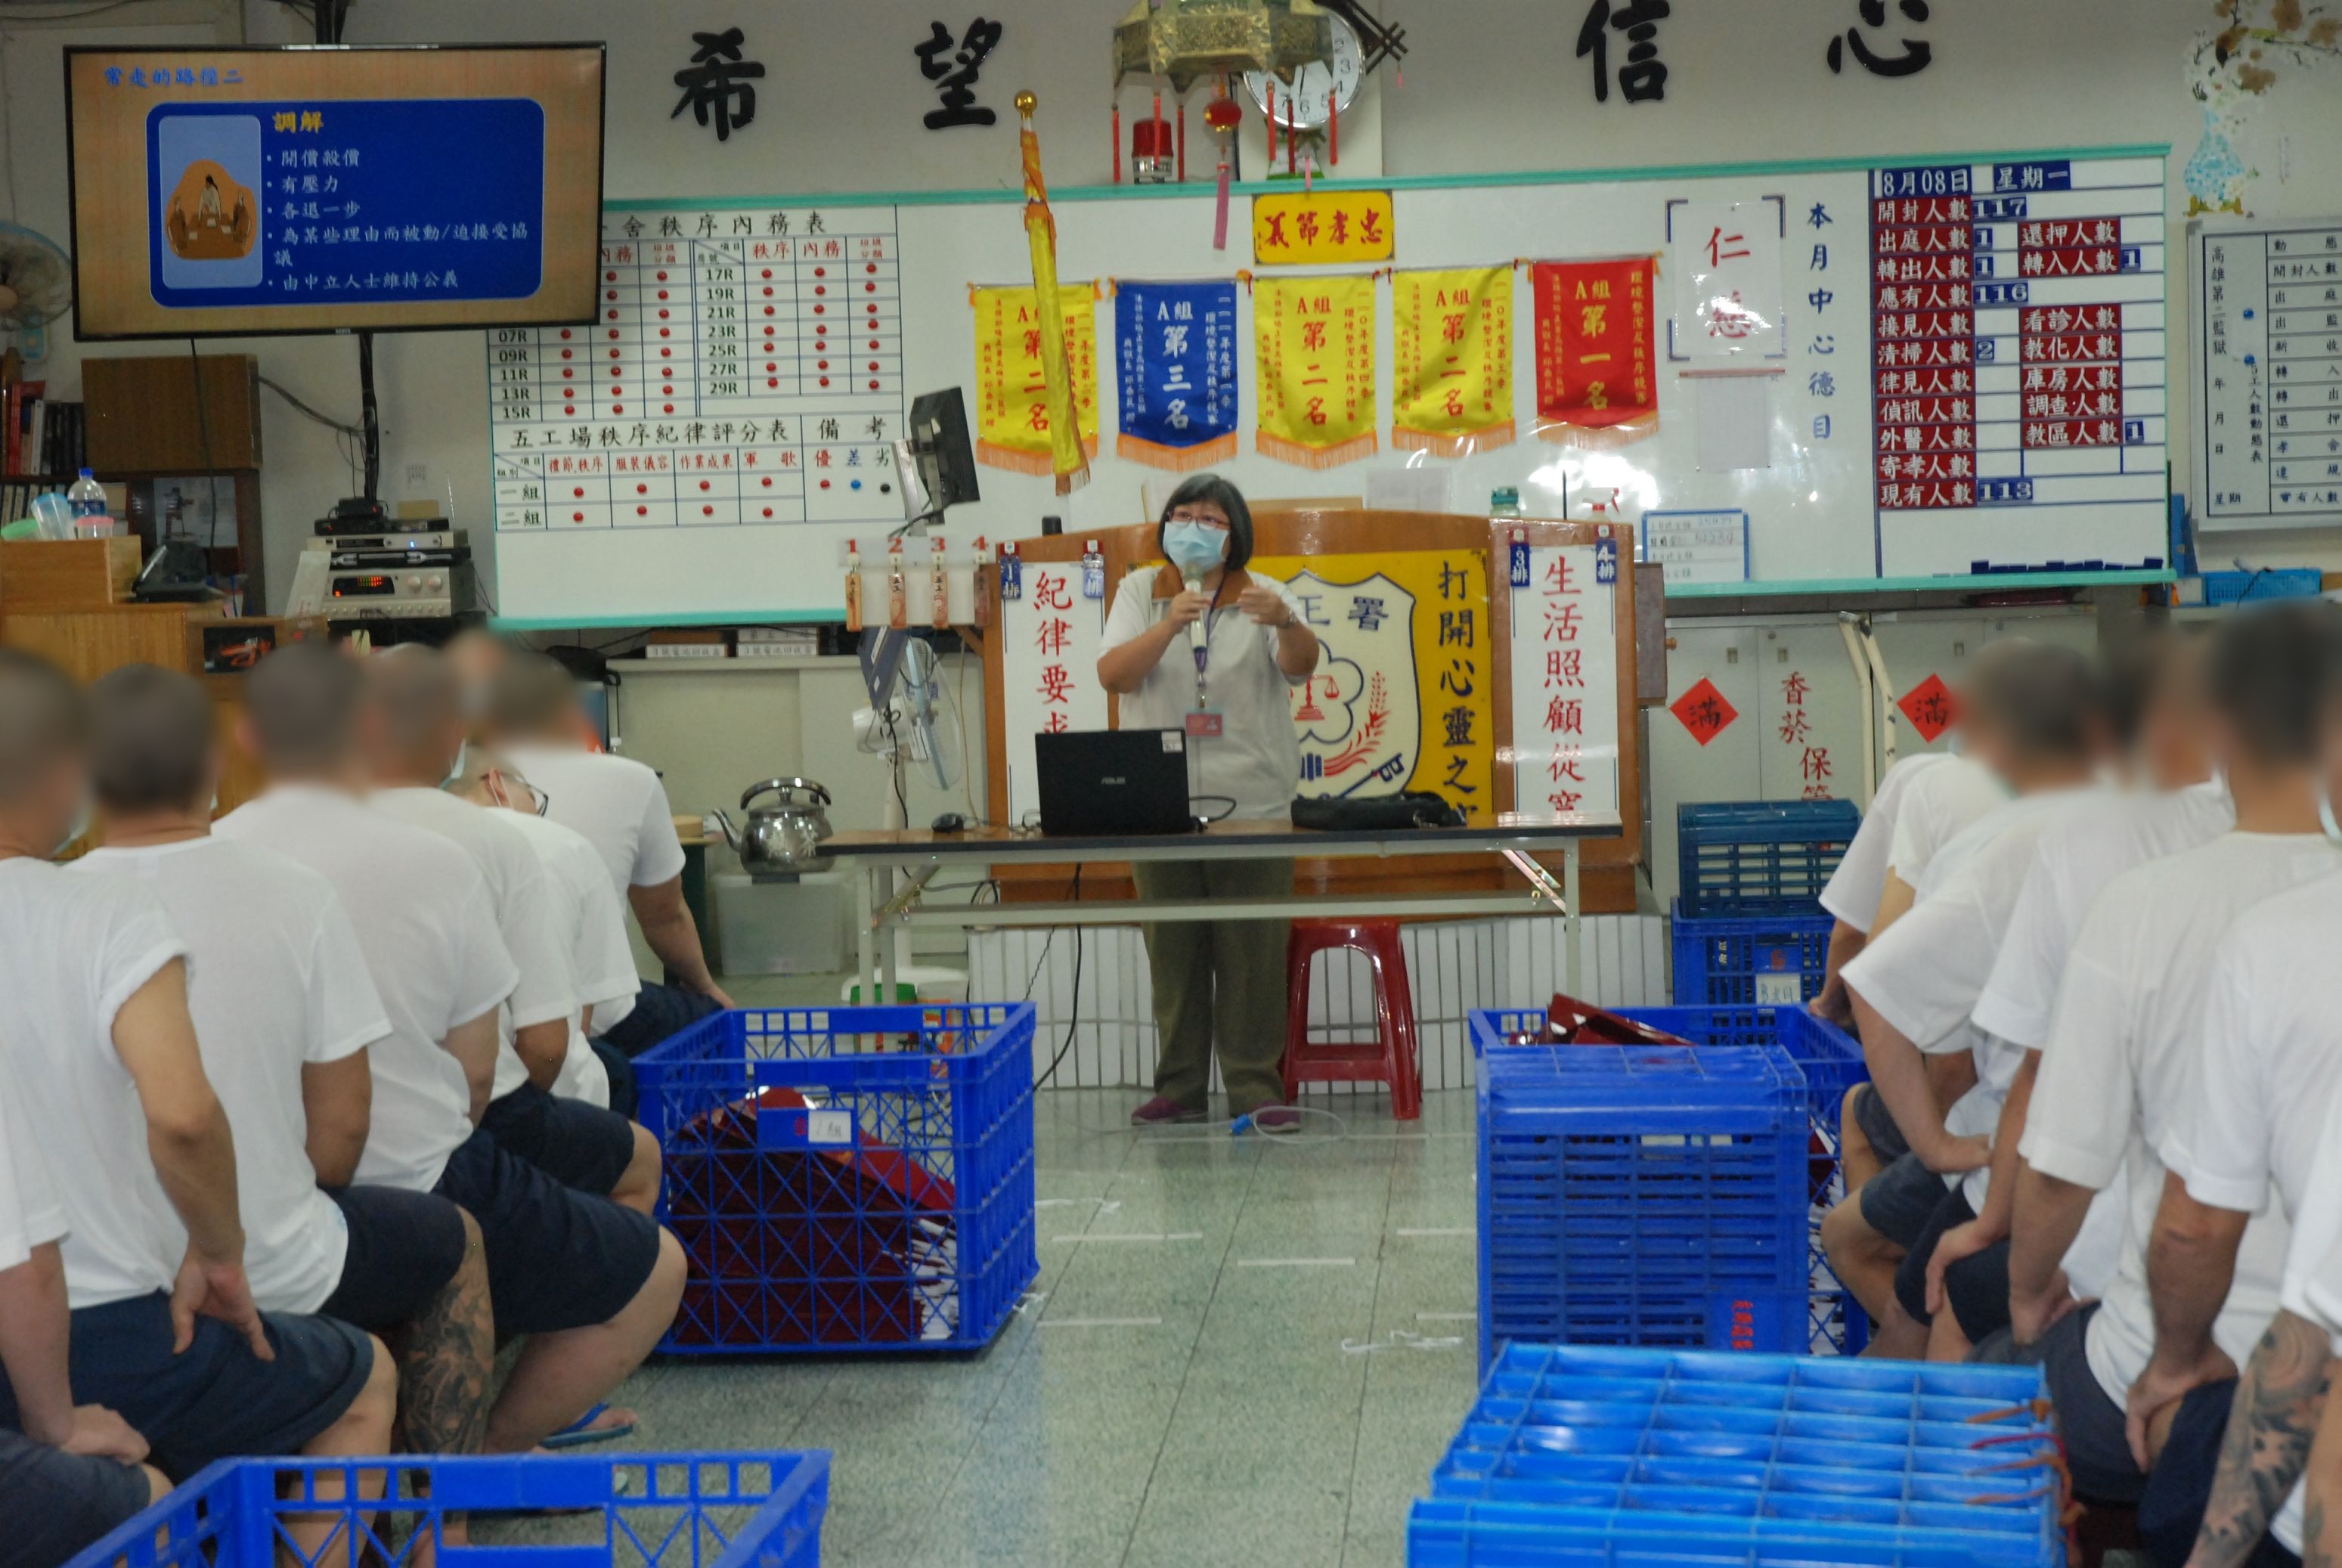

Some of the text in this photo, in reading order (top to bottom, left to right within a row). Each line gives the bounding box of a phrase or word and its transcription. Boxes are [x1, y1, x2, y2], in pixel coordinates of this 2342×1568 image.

[1576, 0, 1932, 103] 信心
[671, 17, 1002, 141] 希望
[273, 110, 325, 135] 調解
[280, 149, 360, 168] 開價殺價
[281, 175, 338, 194] 有壓力
[1882, 168, 1969, 197] 8月08日
[1996, 166, 2069, 191] 星期一
[283, 200, 361, 219] 各退一步
[1878, 197, 1970, 225] 開封人數
[1973, 197, 2026, 218] 117
[603, 212, 826, 238] 舍秩序內務表
[2021, 219, 2117, 248] 還押人數
[1878, 226, 1970, 253] 出庭人數
[1976, 228, 1992, 247] 1
[752, 240, 790, 259] 秩序
[802, 240, 841, 259] 內務
[2124, 249, 2139, 267] 1
[1877, 254, 1970, 282] 轉出人數
[1975, 257, 1993, 275] 1
[2021, 248, 2117, 276] 轉入人數
[2273, 261, 2338, 278] 開封人數
[283, 269, 458, 291] 由中立人士維持公義
[706, 268, 734, 281] 17R
[706, 287, 735, 301] 19R
[1436, 288, 1470, 307] A組
[1575, 279, 1611, 300] A組
[1878, 282, 1970, 310] 應有人數
[1975, 283, 2028, 302] 116
[1296, 296, 1331, 315] A組
[2211, 245, 2227, 355] 高雄第二監獄
[708, 306, 736, 320] 21R
[1157, 301, 1194, 321] A組
[1807, 202, 1835, 440] 本月中心德目
[2024, 305, 2118, 333] 看診人數
[498, 328, 528, 342] 07R
[708, 325, 736, 339] 23R
[1879, 311, 1971, 339] 接見人數
[499, 348, 528, 362] 09R
[708, 344, 737, 358] 25R
[1580, 304, 1612, 411] 第一名
[1878, 340, 1971, 366] 清掃人數
[1978, 341, 1993, 361] 2
[2024, 334, 2117, 361] 教化人數
[500, 367, 528, 382] 11R
[709, 363, 738, 376] 27R
[1301, 321, 1328, 425] 第二名
[1439, 312, 1467, 417] 第二名
[1162, 325, 1192, 429] 第三名
[1880, 369, 1972, 395] 律見人數
[2024, 366, 2118, 392] 庫房人數
[501, 386, 530, 401] 13R
[709, 382, 738, 395] 29R
[503, 405, 531, 420] 15R
[1880, 398, 1972, 423] 偵訊人數
[2028, 392, 2119, 418] 調查人數
[818, 415, 888, 442] 備考
[2214, 411, 2225, 426] 月
[510, 417, 789, 449] 五工場秩序紀律評分表
[1880, 426, 1972, 451] 外醫人數
[2026, 420, 2119, 446] 教區人數
[2127, 422, 2143, 440] 1
[615, 454, 669, 472] 服裝儀容
[680, 453, 733, 470] 作業成果
[744, 450, 798, 468] 軍歌
[814, 448, 832, 468] 優
[845, 449, 862, 467] 差
[874, 448, 891, 467] 劣
[500, 483, 540, 501] 一組
[1882, 481, 1972, 507] 現有人數
[2214, 491, 2241, 505] 星期
[501, 509, 542, 526] 二組
[847, 538, 857, 553] 1
[888, 538, 903, 553] 2
[931, 537, 946, 552] 3
[971, 535, 987, 551] 4
[1512, 548, 1529, 584] 3排
[1597, 544, 1616, 579] 4排
[1438, 560, 1478, 815] 打開心靈之
[1688, 696, 1721, 730] 滿
